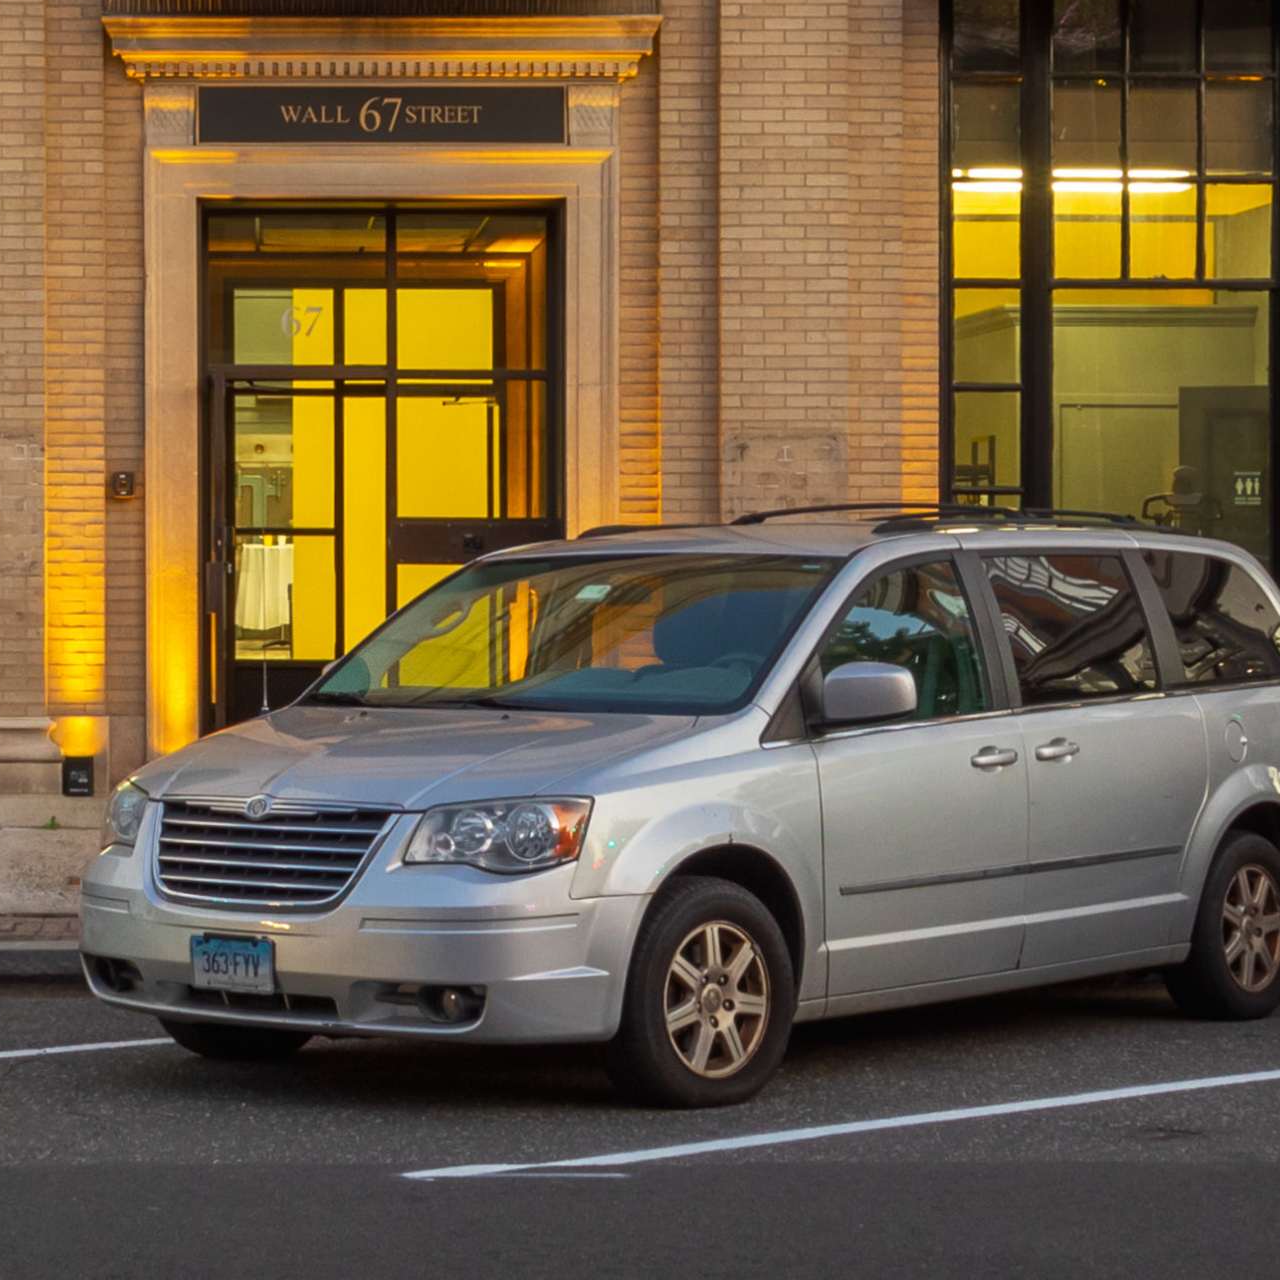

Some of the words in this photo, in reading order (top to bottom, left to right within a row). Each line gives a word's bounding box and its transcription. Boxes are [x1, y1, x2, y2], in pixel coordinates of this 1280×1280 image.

[280, 105, 350, 124] WALL
[358, 96, 403, 133] 67
[405, 104, 482, 125] STREET
[280, 306, 322, 337] 67
